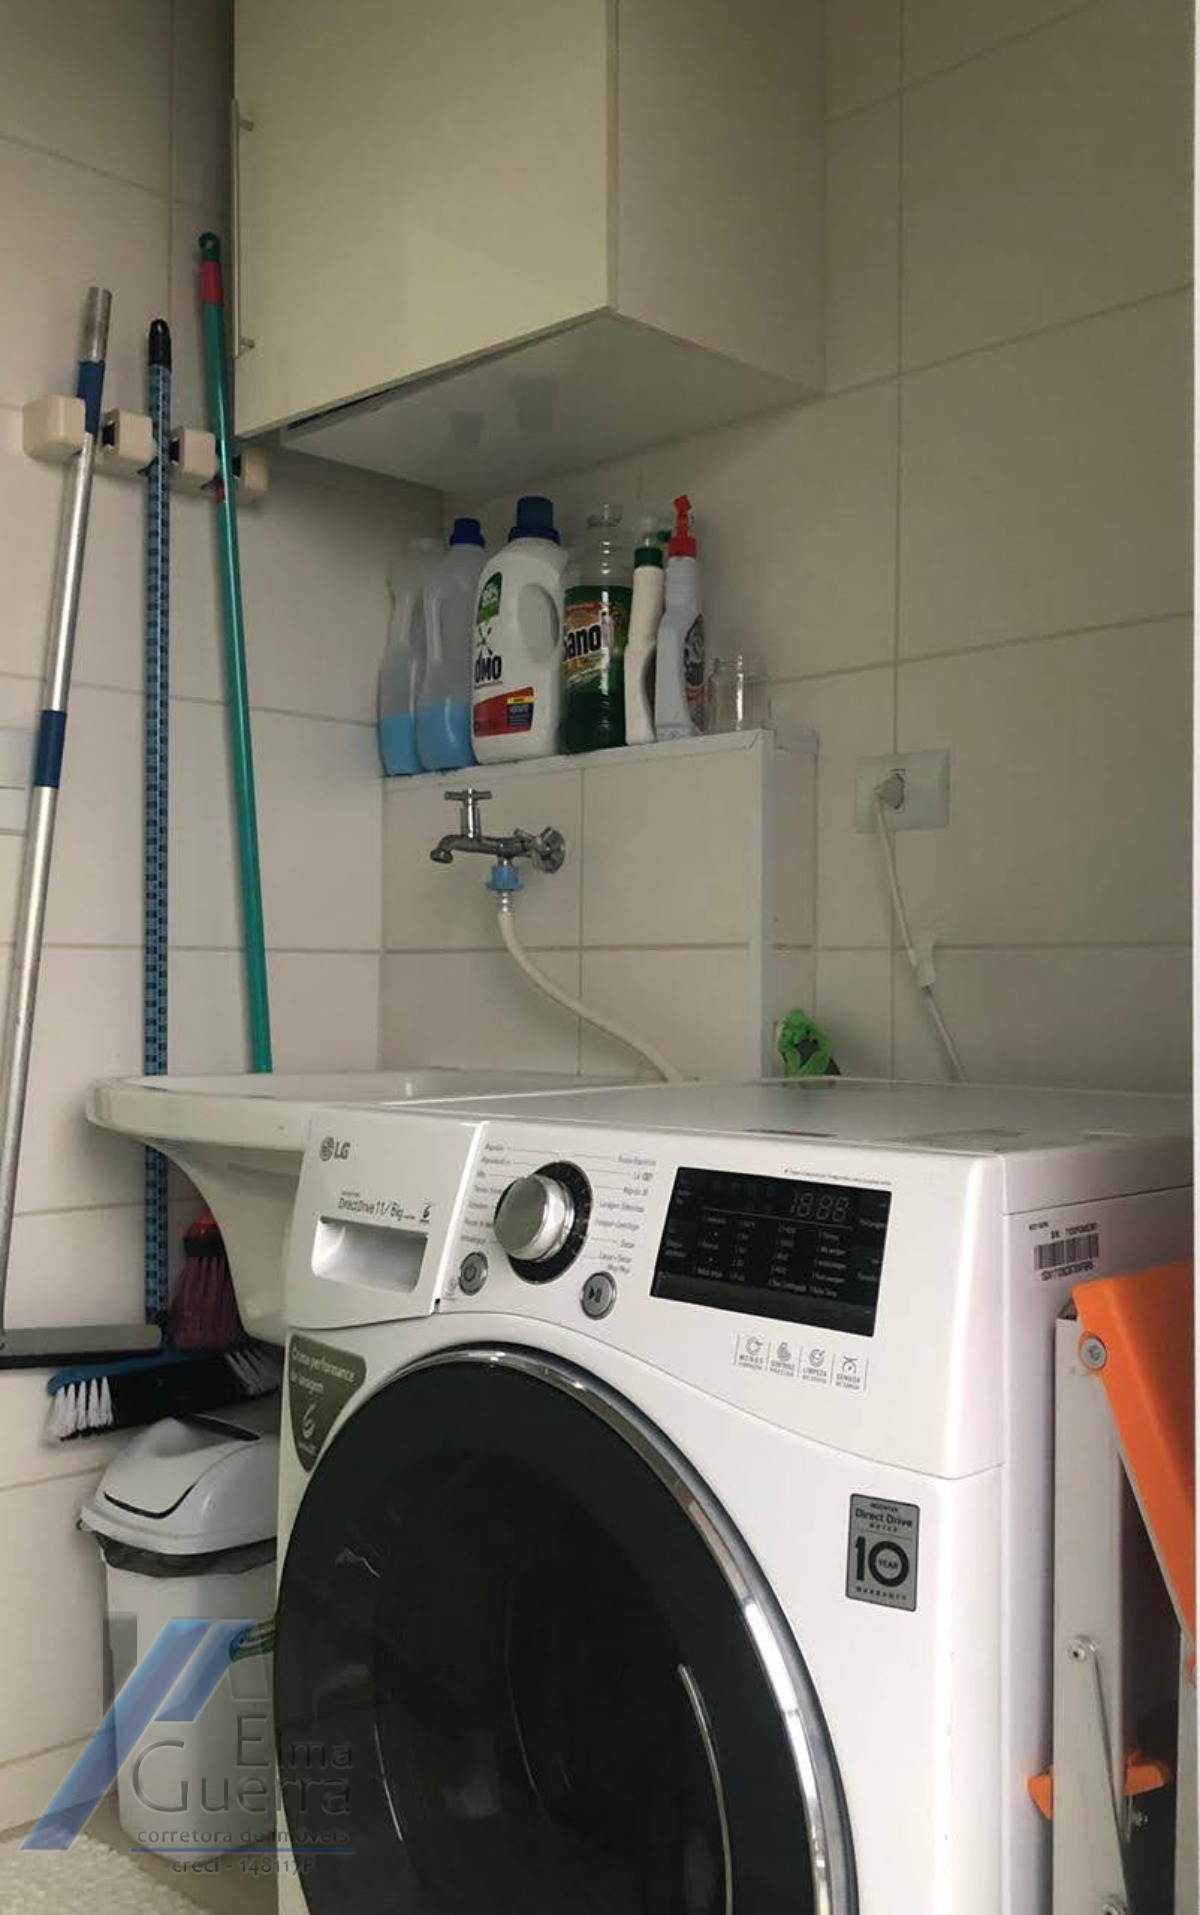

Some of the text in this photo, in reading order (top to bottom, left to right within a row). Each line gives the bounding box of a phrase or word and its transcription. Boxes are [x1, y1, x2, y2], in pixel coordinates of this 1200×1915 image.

[475, 656, 502, 683] OMO
[334, 1141, 351, 1160] LG
[855, 1508, 913, 1527] Direct Drive
[855, 1536, 910, 1588] 10
[879, 1559, 899, 1570] YEAR
